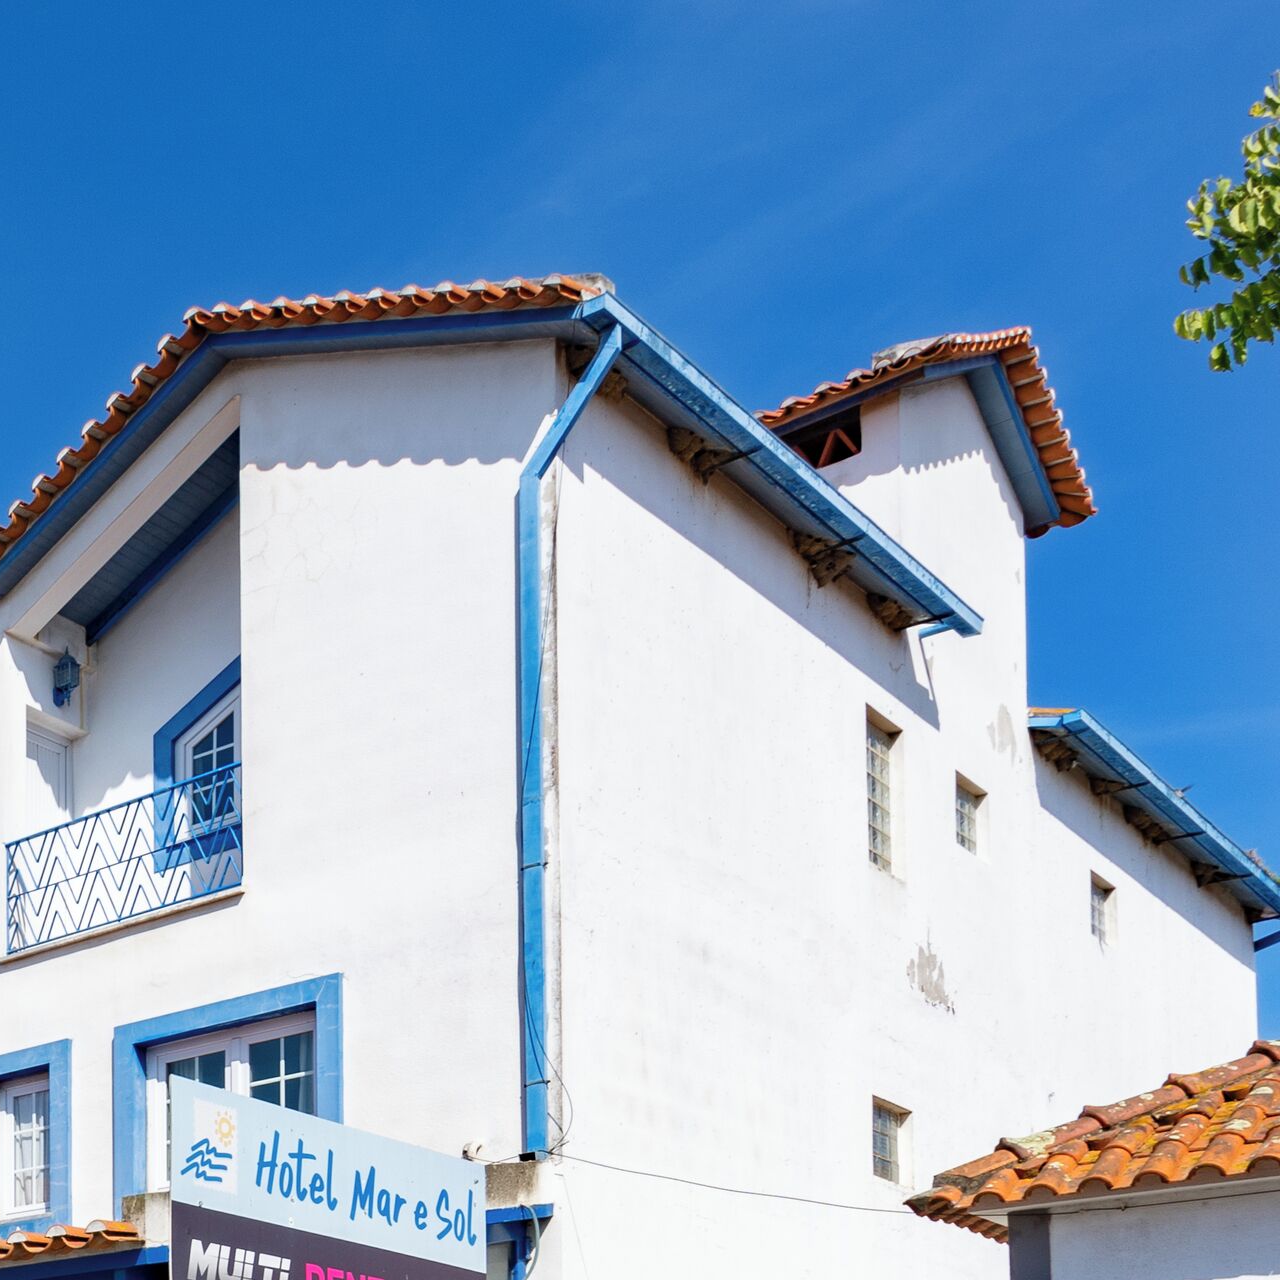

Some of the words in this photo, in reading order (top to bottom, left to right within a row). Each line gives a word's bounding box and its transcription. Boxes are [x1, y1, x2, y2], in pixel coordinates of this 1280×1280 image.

[256, 1130, 338, 1212] Hotel
[349, 1165, 407, 1227] Mar
[413, 1200, 429, 1231] e
[435, 1188, 478, 1247] Sol
